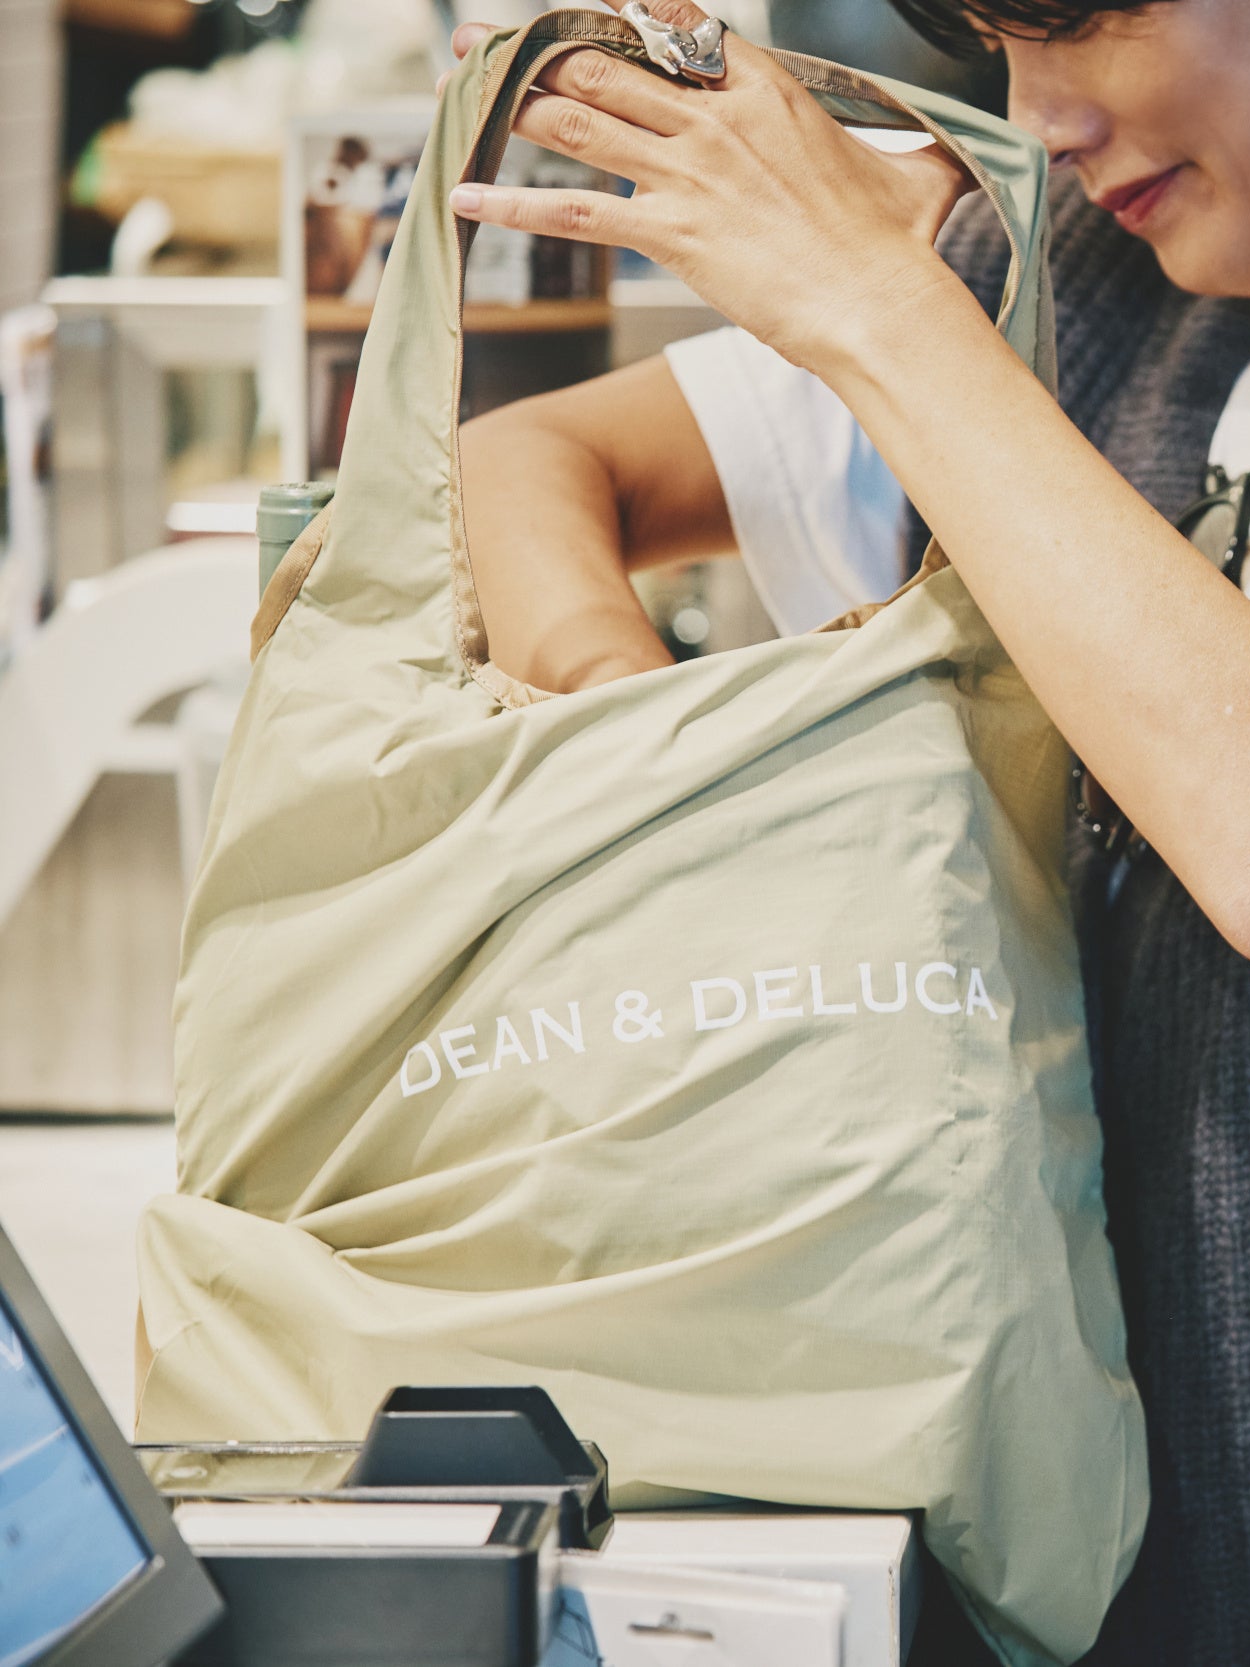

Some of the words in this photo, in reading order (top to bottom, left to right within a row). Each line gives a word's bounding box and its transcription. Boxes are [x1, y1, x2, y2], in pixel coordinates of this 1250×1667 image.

[400, 1001, 586, 1097] DEAN
[611, 989, 665, 1043] &
[691, 961, 998, 1032] DELUCA
